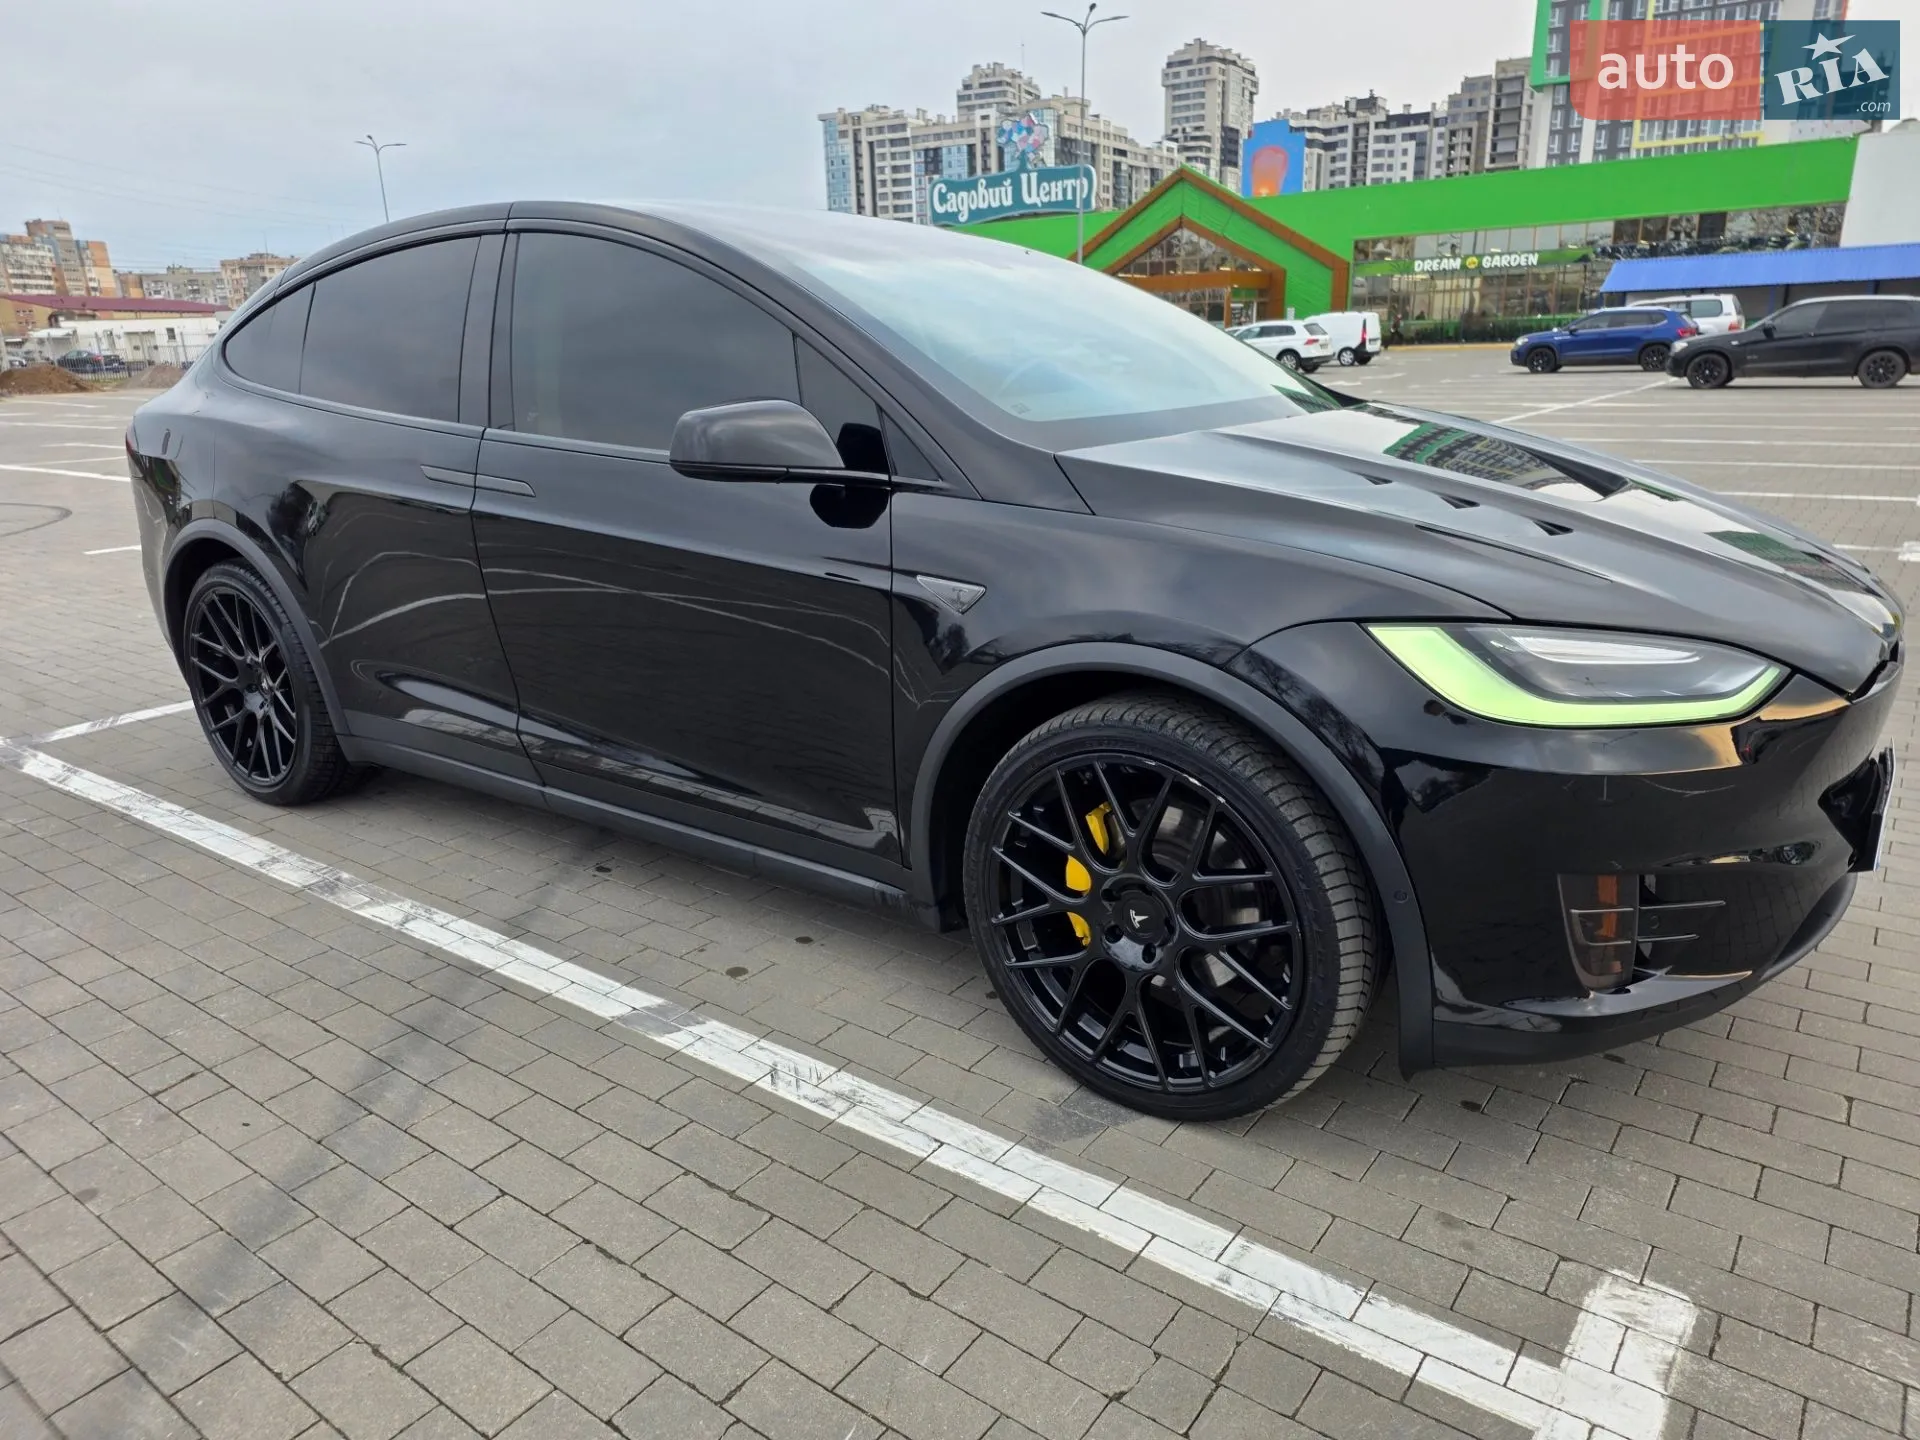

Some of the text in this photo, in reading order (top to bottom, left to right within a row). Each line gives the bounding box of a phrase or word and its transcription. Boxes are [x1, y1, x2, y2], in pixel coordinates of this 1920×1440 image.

[932, 171, 1089, 222] Садовий Центр
[1414, 252, 1539, 272] DREAM GARDEN
